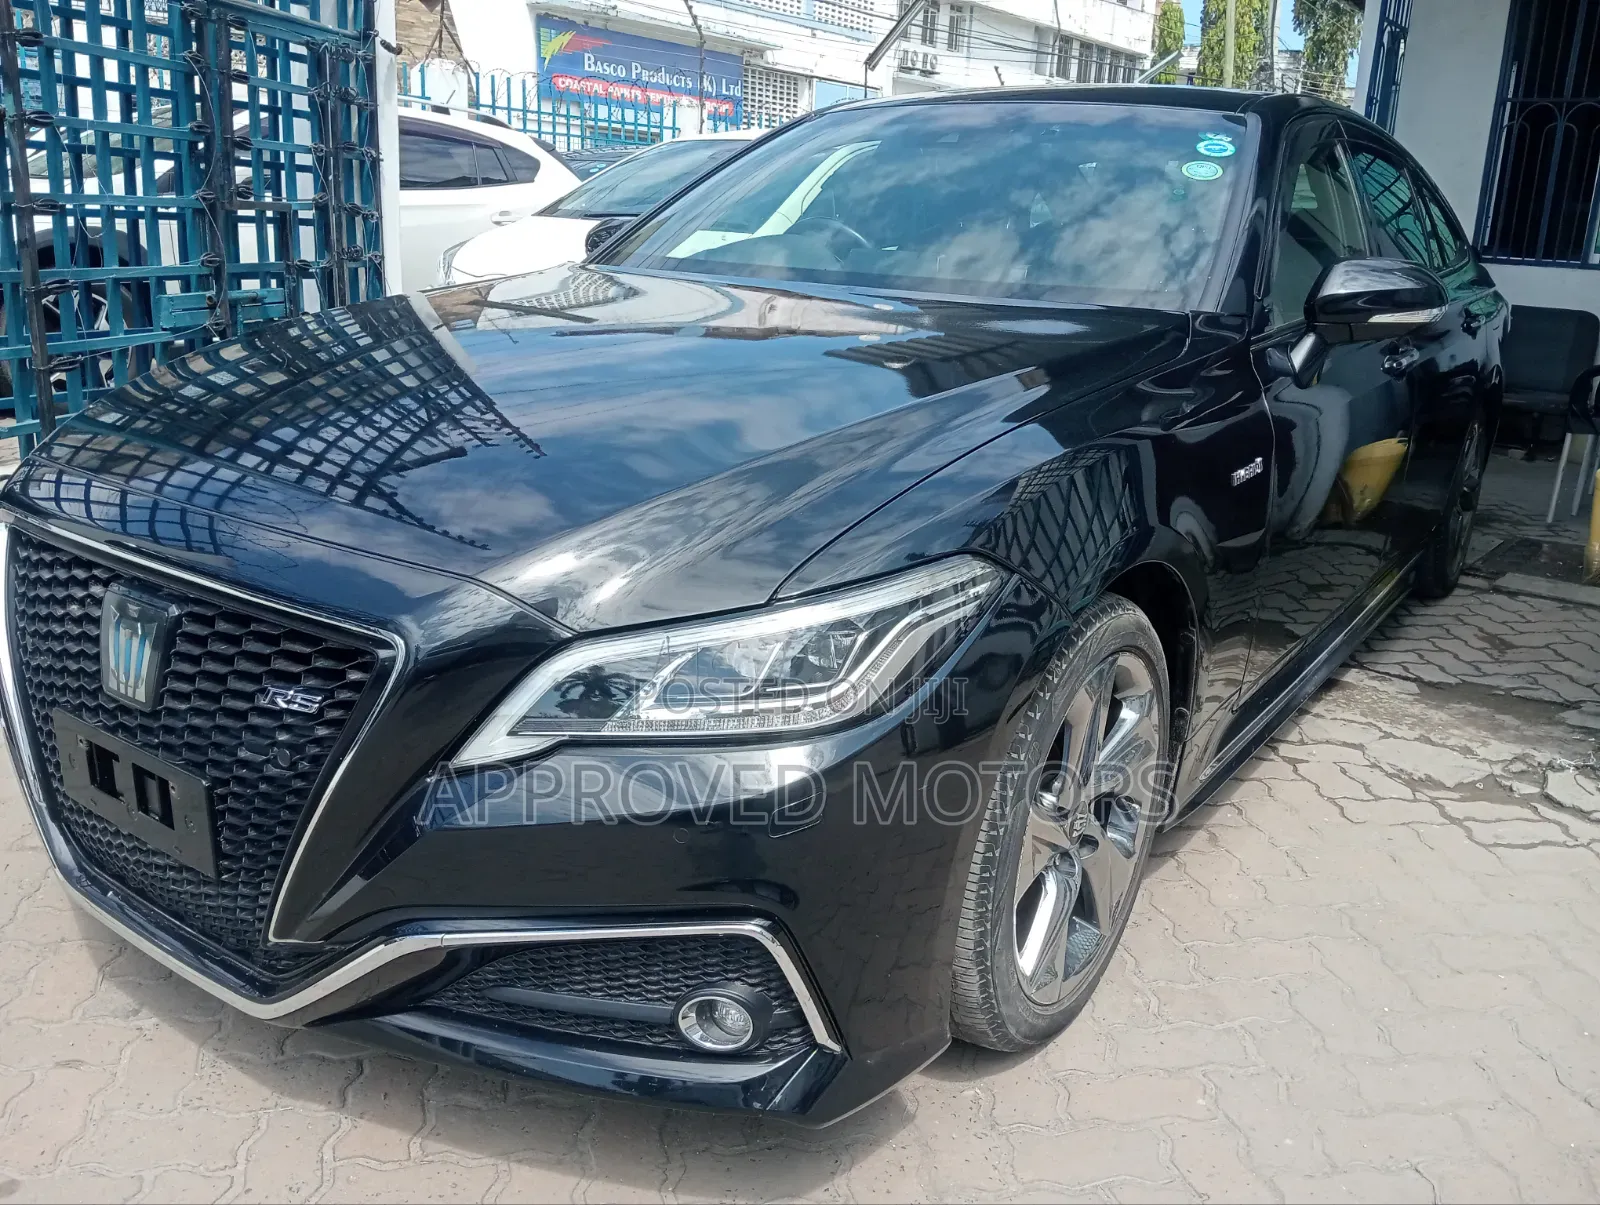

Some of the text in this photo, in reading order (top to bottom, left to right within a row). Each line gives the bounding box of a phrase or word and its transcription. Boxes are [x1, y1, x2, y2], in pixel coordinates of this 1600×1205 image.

[584, 52, 626, 78] Basco
[631, 61, 693, 89] Products
[722, 78, 742, 97] Ltd
[260, 686, 322, 714] RS
